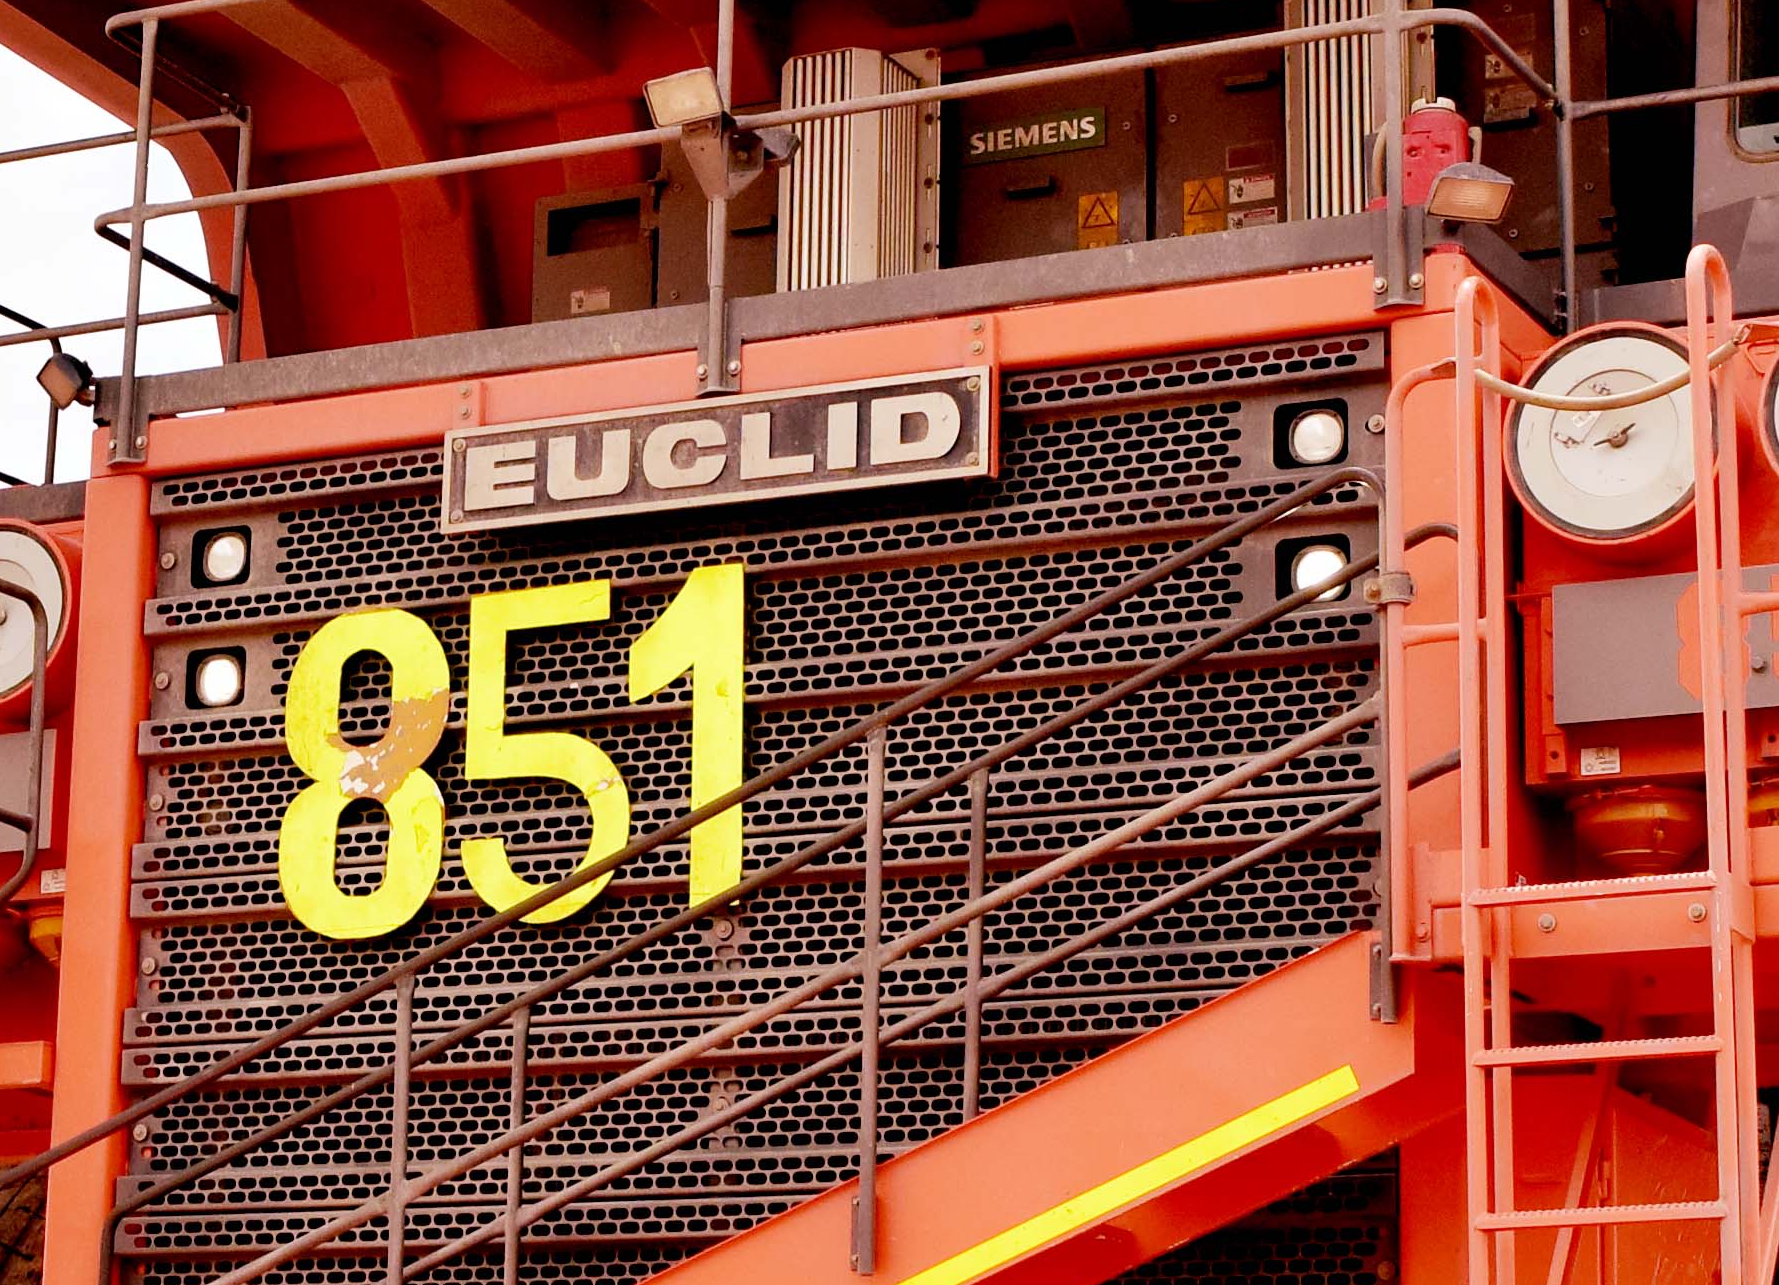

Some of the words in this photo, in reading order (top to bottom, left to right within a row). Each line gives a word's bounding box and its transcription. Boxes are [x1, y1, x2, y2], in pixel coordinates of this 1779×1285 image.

[970, 116, 1096, 154] SIEMENS
[464, 391, 961, 511] EUCLID
[279, 563, 743, 940] 851
